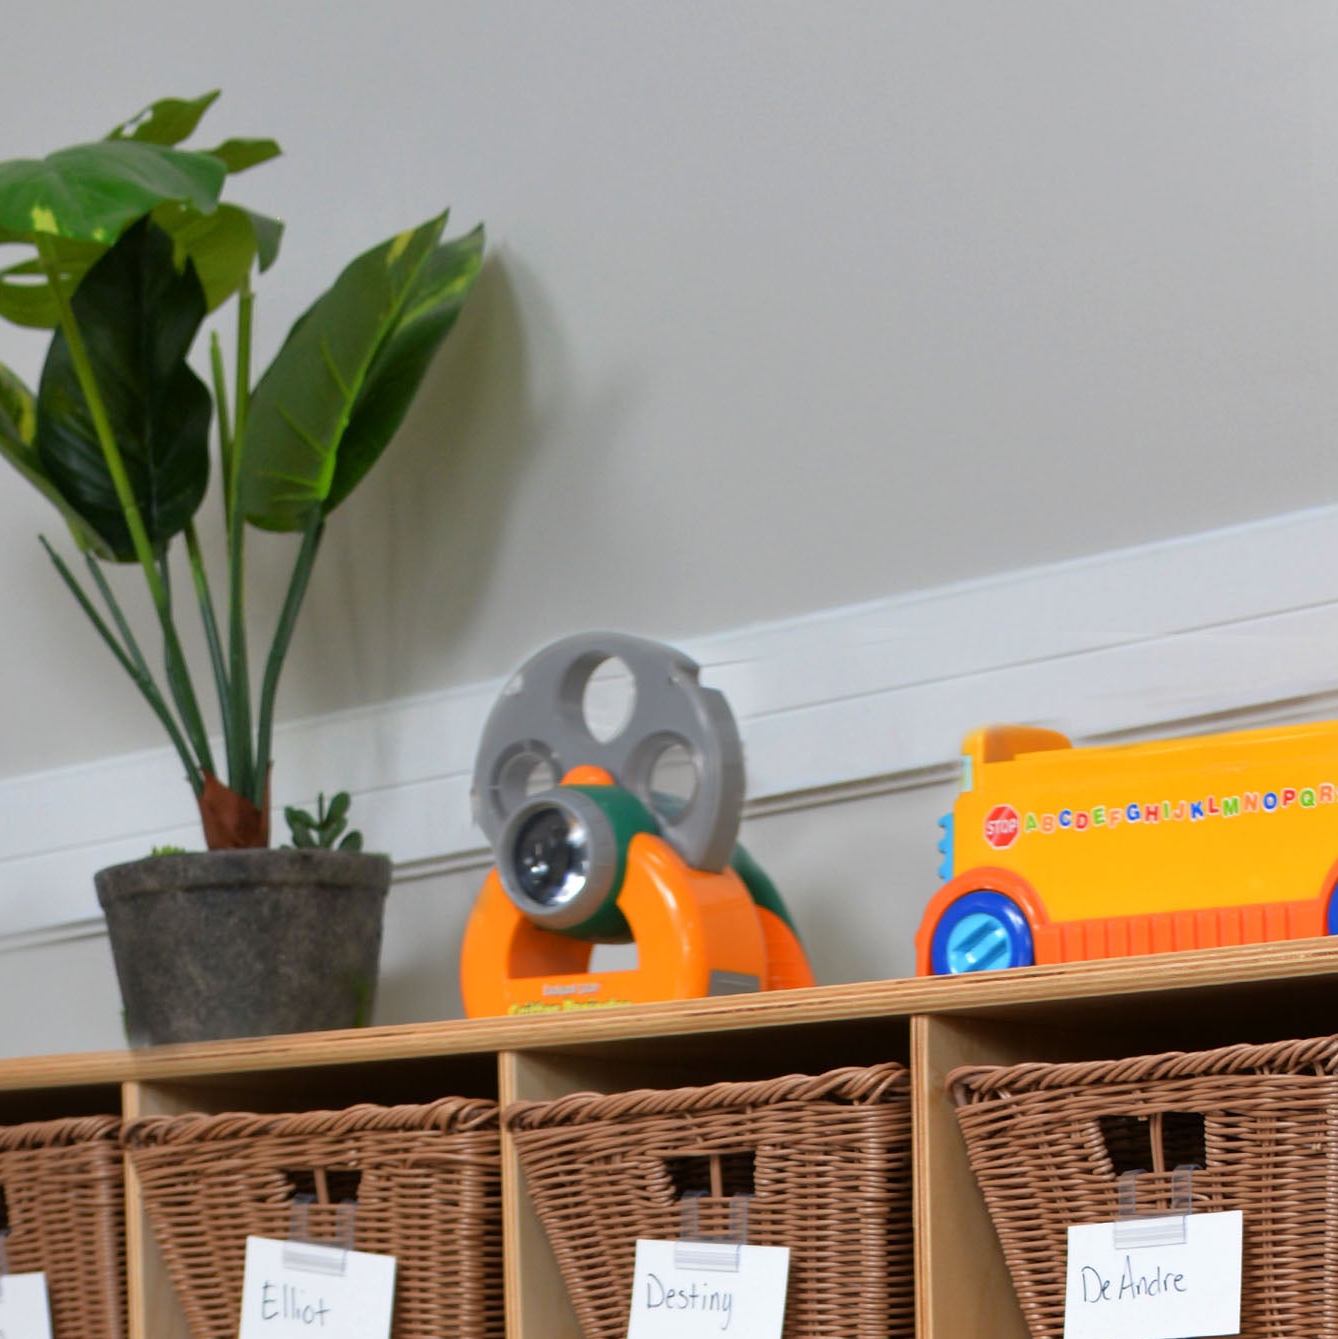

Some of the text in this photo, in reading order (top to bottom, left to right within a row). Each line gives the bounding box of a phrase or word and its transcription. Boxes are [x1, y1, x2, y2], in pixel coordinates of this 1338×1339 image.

[986, 818, 1018, 836] STOP
[261, 1281, 331, 1326] Elliot
[645, 1274, 735, 1331] Destiny
